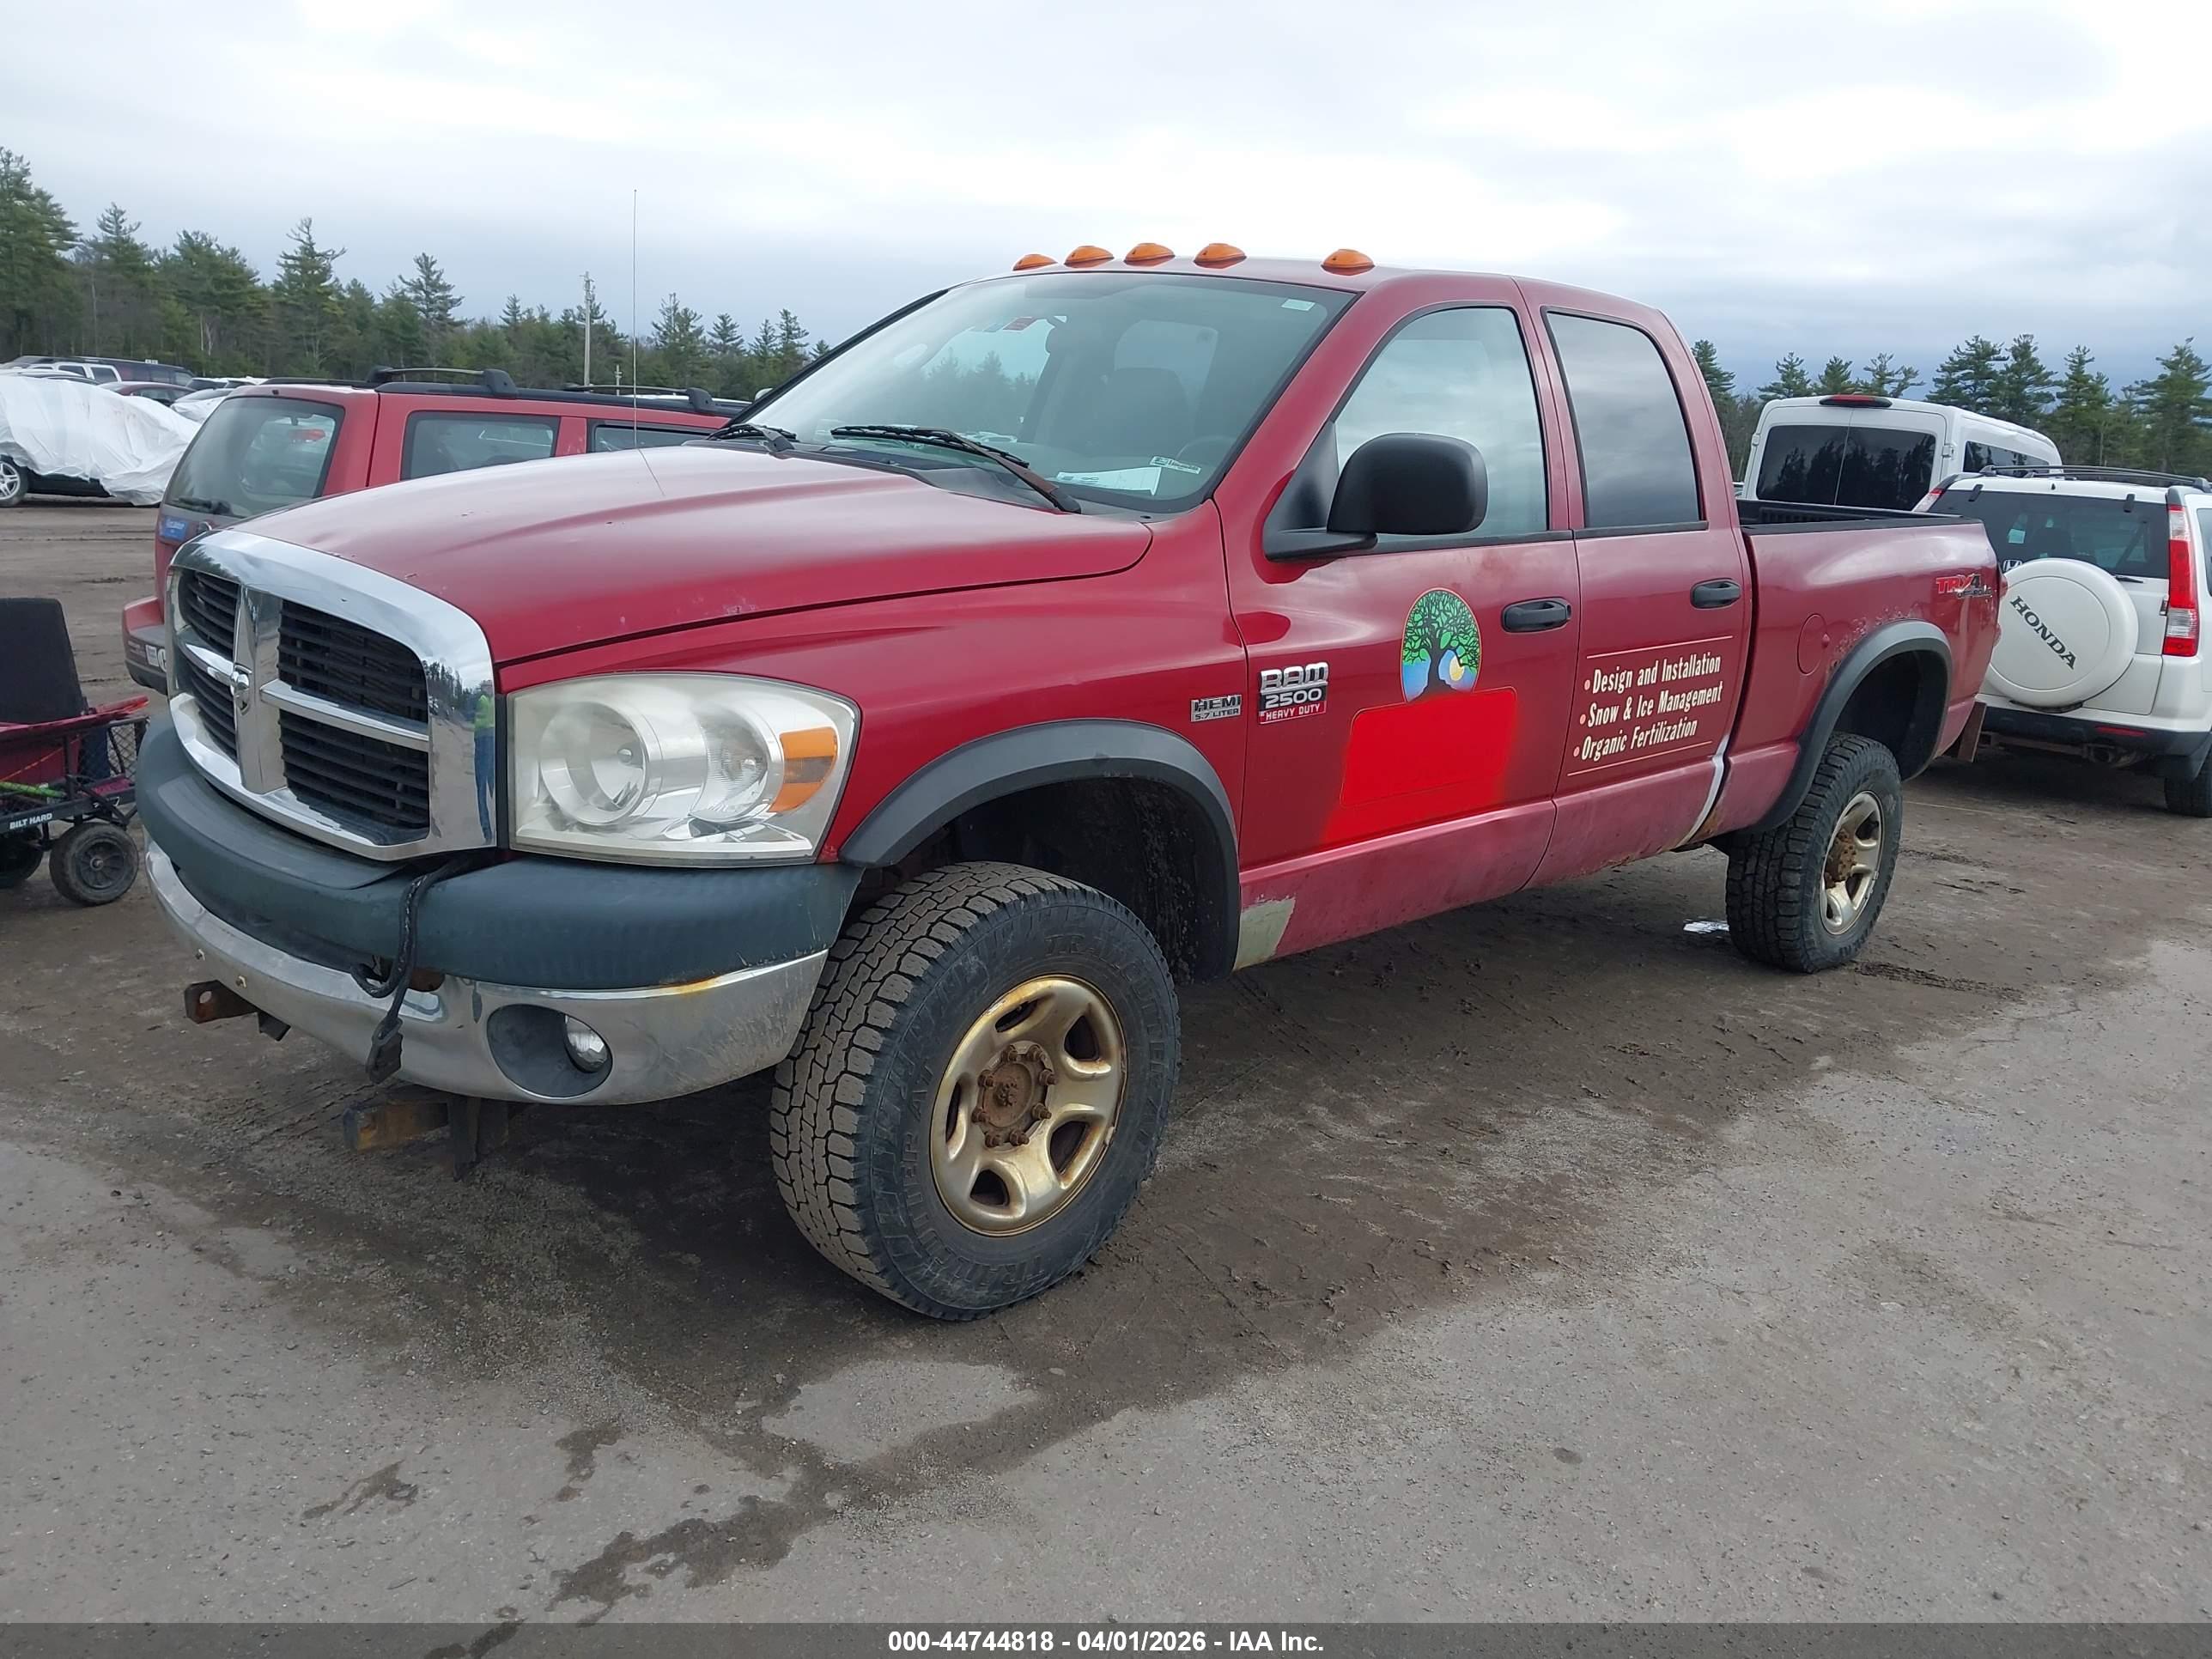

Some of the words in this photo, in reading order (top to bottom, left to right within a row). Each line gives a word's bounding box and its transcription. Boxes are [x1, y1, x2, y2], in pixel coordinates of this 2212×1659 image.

[2010, 596, 2076, 670] HONDA
[1260, 662, 1329, 691] RAM
[1592, 666, 1633, 694] Design
[1637, 660, 1659, 686] and
[1662, 652, 1721, 683] Installation
[1194, 695, 1243, 712] HEMI
[1265, 688, 1322, 709] 2500
[1588, 702, 1620, 727] Snow
[1623, 696, 1633, 720] &
[1636, 695, 1654, 718] Ice
[1657, 681, 1723, 713] Management
[1194, 712, 1210, 720] 5.7
[1212, 708, 1240, 718] LITER
[1266, 708, 1295, 721] HEAVY
[1298, 703, 1321, 716] DUTY
[1581, 730, 1628, 761] Organic
[1631, 716, 1698, 750] Fertilization
[9, 818, 27, 830] BILT
[29, 812, 53, 825] HARD
